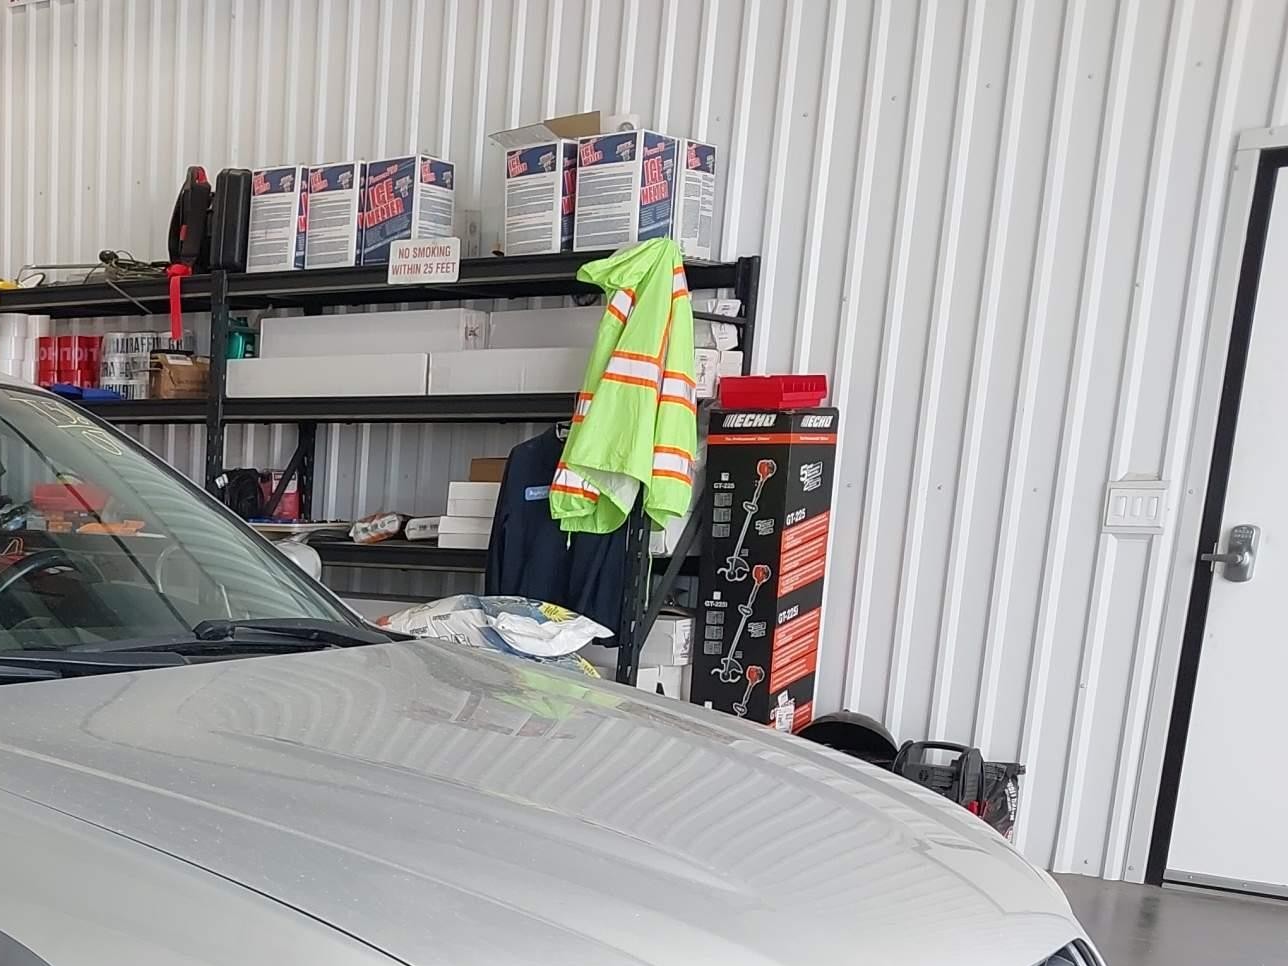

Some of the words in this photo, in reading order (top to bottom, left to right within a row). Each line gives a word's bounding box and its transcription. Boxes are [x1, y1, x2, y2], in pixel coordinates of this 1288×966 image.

[644, 156, 664, 186] ICE
[369, 178, 395, 210] ICE
[398, 247, 410, 259] NO
[413, 245, 451, 258] SMOKING
[392, 263, 421, 276] WITHIN
[423, 263, 434, 274] 25
[436, 261, 457, 273] FEET
[732, 413, 777, 428] ECHO
[807, 415, 834, 428] ECHO
[786, 508, 806, 526] GT-225
[778, 604, 799, 624] GT-225i
